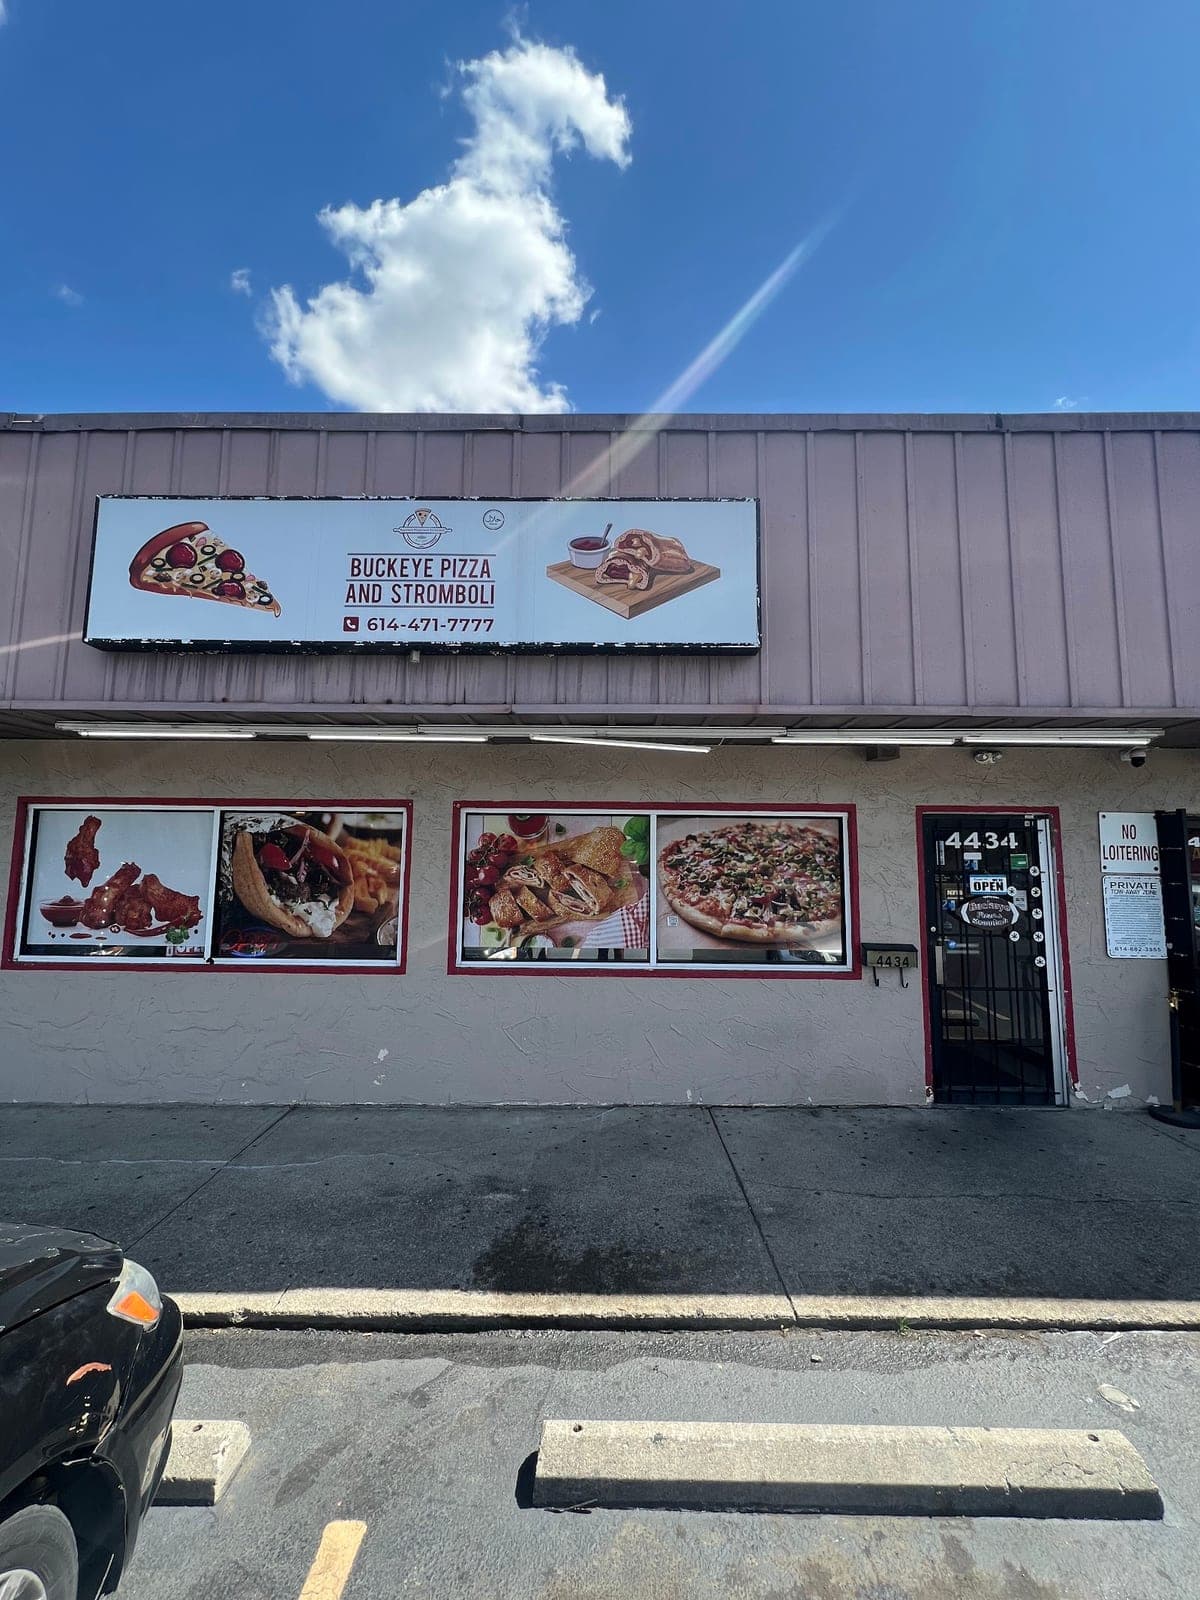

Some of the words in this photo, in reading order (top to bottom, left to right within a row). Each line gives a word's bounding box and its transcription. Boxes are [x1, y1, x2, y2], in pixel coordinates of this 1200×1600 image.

[351, 558, 434, 578] BUCKEYE
[440, 558, 491, 579] PIZZA
[345, 583, 382, 604] AND
[391, 584, 495, 604] STROMBOLI
[367, 617, 494, 632] 614-471-7777
[1122, 824, 1137, 840] NO
[945, 832, 1018, 849] 4434
[1103, 845, 1159, 861] LOITERING
[974, 881, 1004, 891] OPEN
[1110, 881, 1157, 890] PRIVATE
[877, 955, 909, 968] 4434
